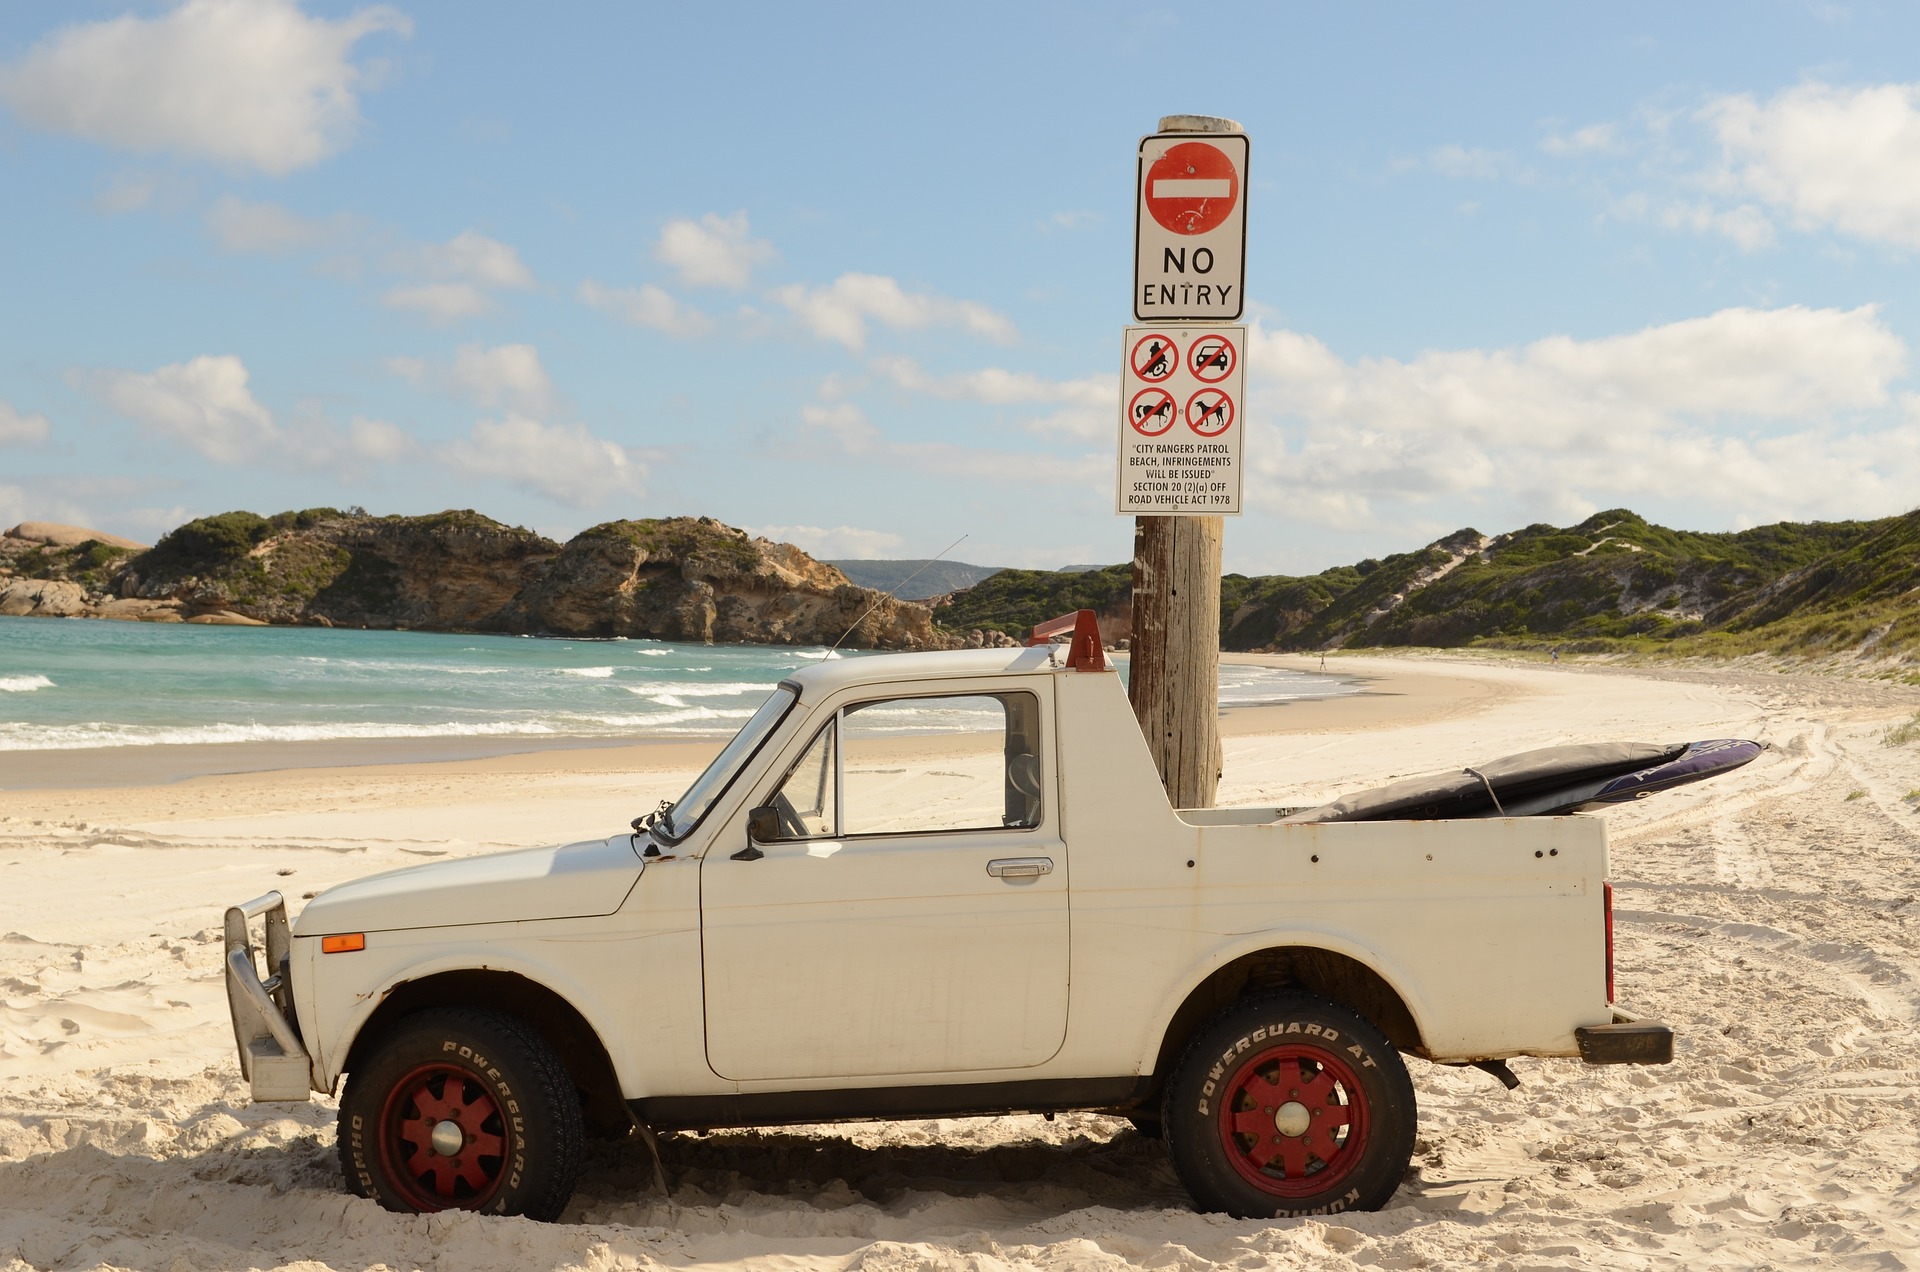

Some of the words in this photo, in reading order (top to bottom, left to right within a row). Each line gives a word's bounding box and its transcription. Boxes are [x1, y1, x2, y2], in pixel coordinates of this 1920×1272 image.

[1164, 247, 1214, 274] NO
[1143, 284, 1232, 305] ENTRY
[1156, 444, 1194, 454] RANGERS
[1197, 444, 1229, 454] PATROL
[1129, 457, 1160, 467] BEACH,
[1162, 457, 1231, 466] INFRINGEMENTS
[1168, 470, 1179, 479] BE
[1133, 482, 1168, 492] SECTION
[1171, 482, 1182, 492] 20
[1184, 482, 1208, 494] (2)(a)
[1210, 483, 1226, 492] OFF
[1128, 495, 1152, 504] ROAD
[1154, 495, 1189, 504] VEHICLE
[1191, 495, 1207, 504] ACT
[1210, 495, 1231, 505] 1978
[1198, 1022, 1339, 1116] POWERGUARD
[1347, 1043, 1376, 1069] AT
[442, 1040, 526, 1190] POWERGUARD
[352, 1115, 381, 1200] KUMHO
